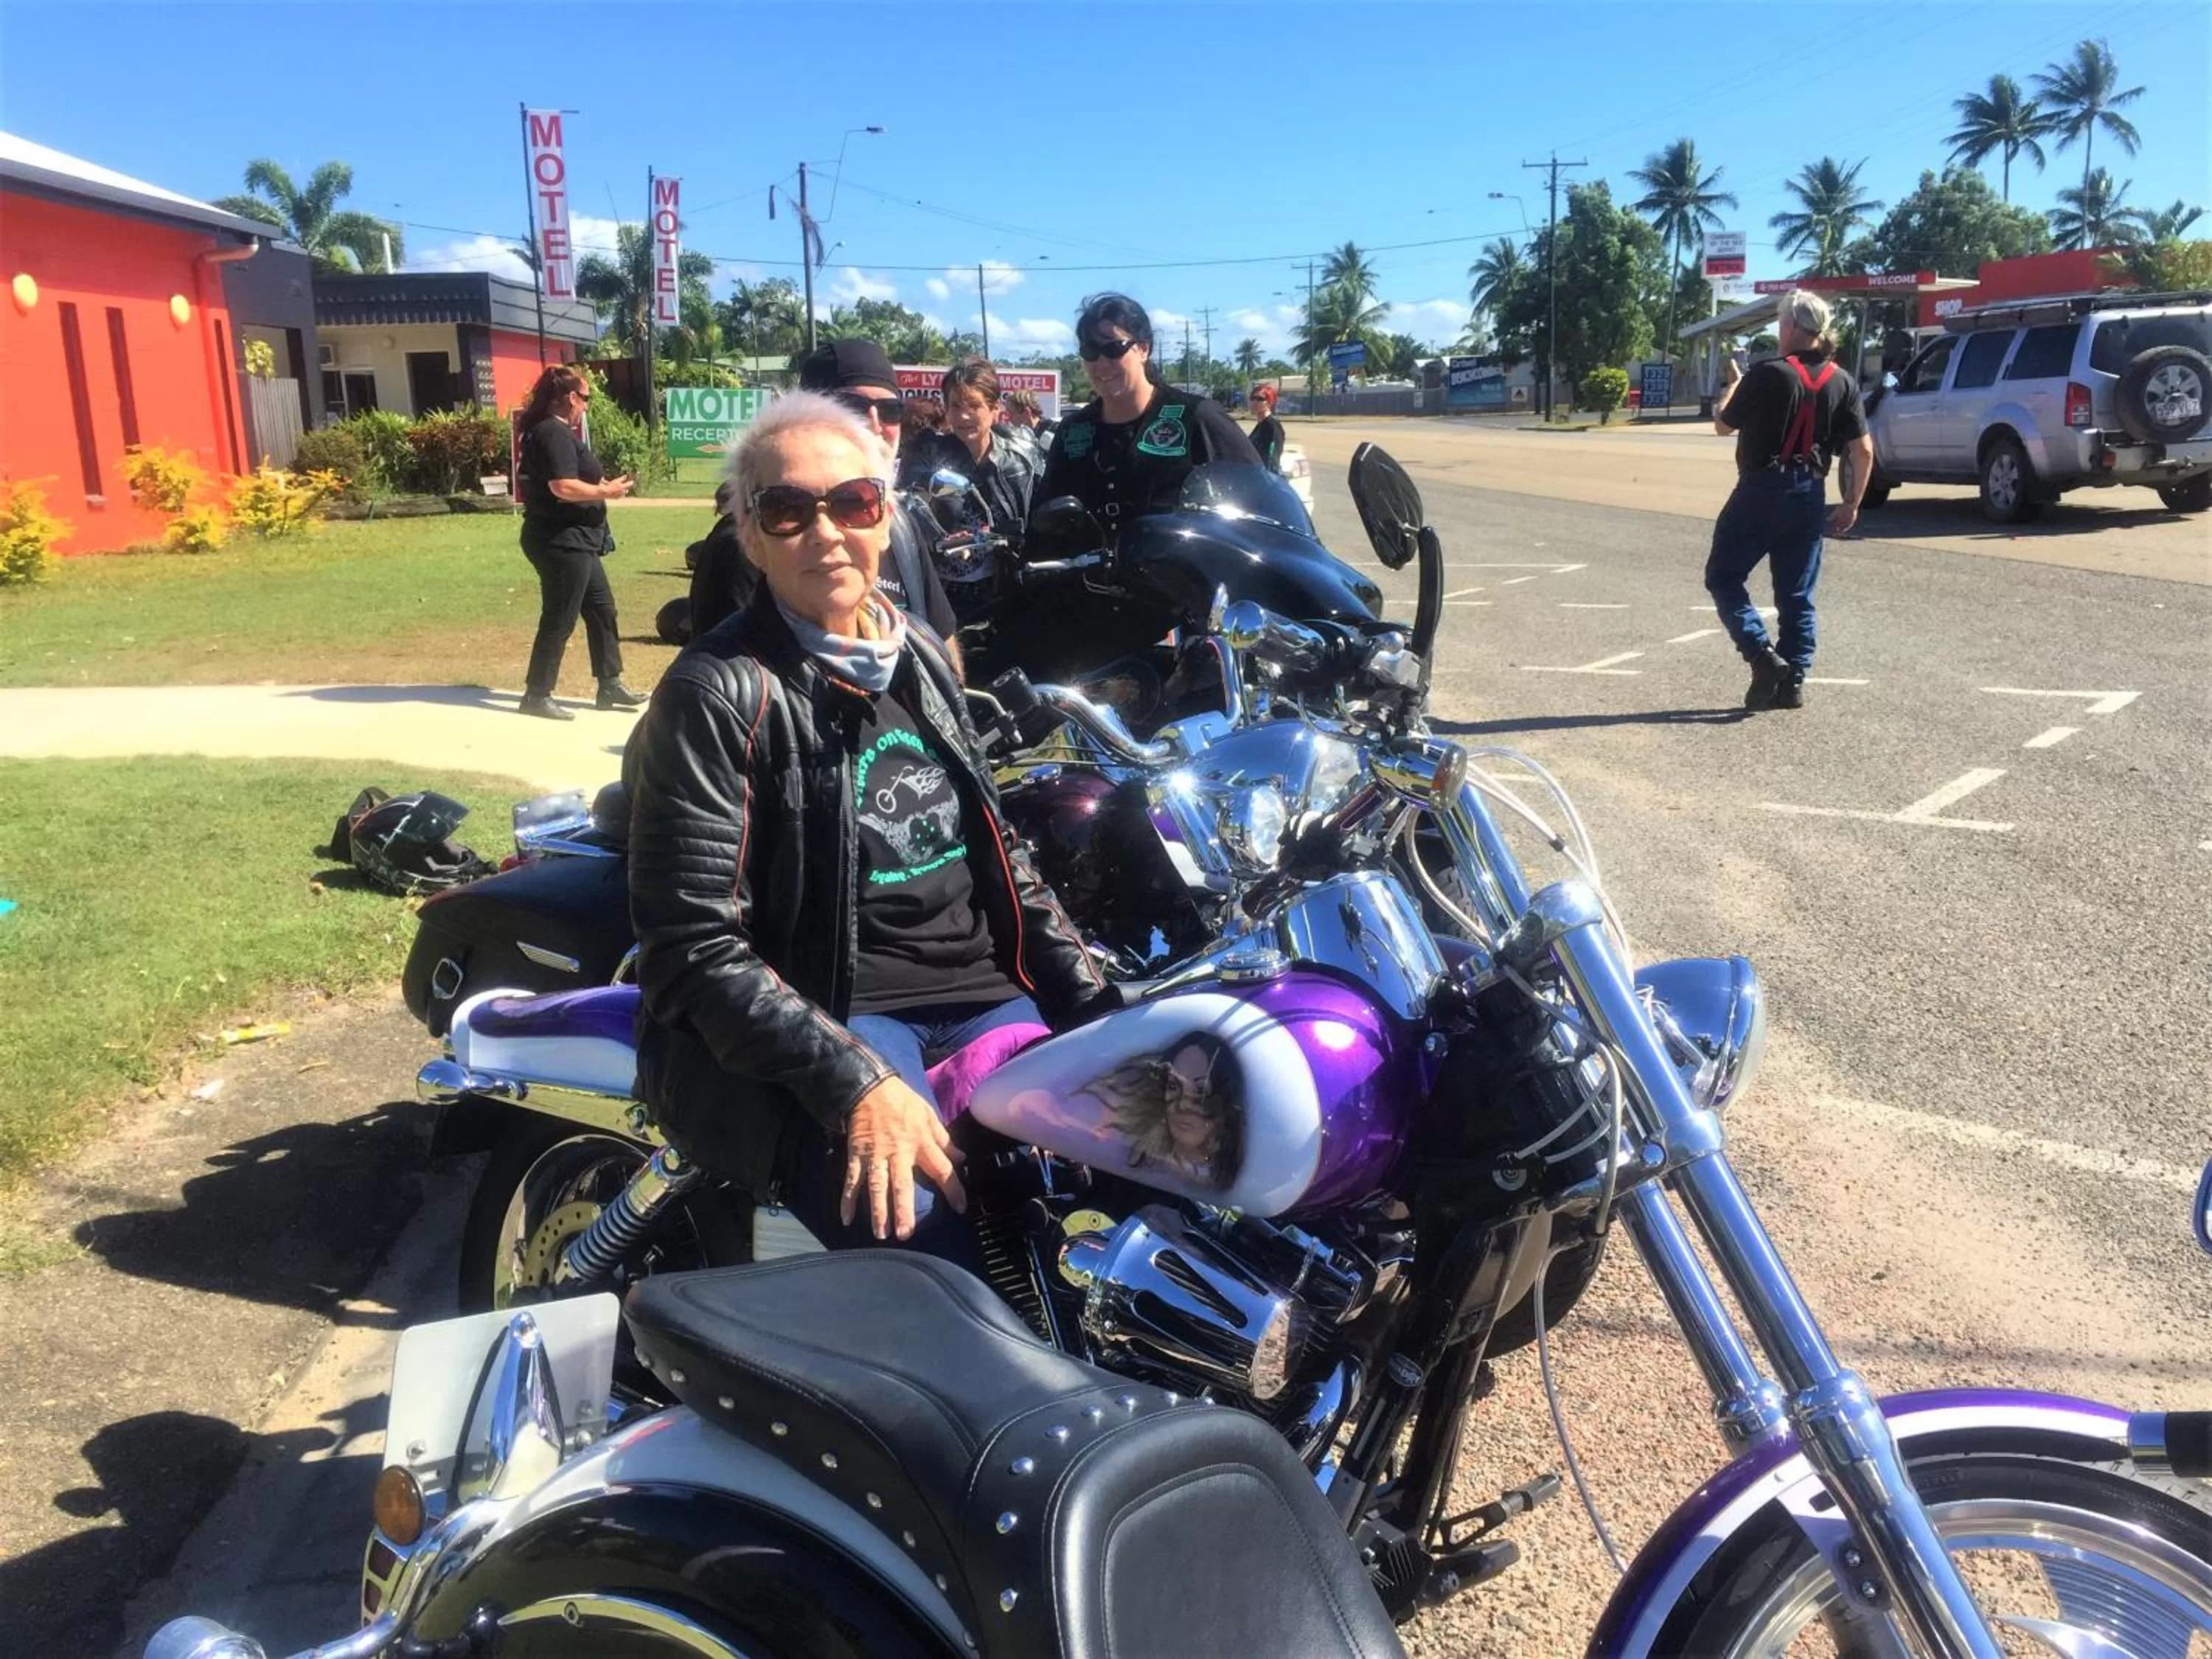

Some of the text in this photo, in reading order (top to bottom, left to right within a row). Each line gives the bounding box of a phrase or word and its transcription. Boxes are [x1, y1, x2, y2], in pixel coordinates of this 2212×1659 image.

[529, 114, 571, 297] MOTEL
[654, 179, 680, 321] MOTEL
[1868, 274, 1917, 286] WELCOME
[1935, 299, 1963, 317] SHOP
[999, 375, 1051, 389] MOTEL
